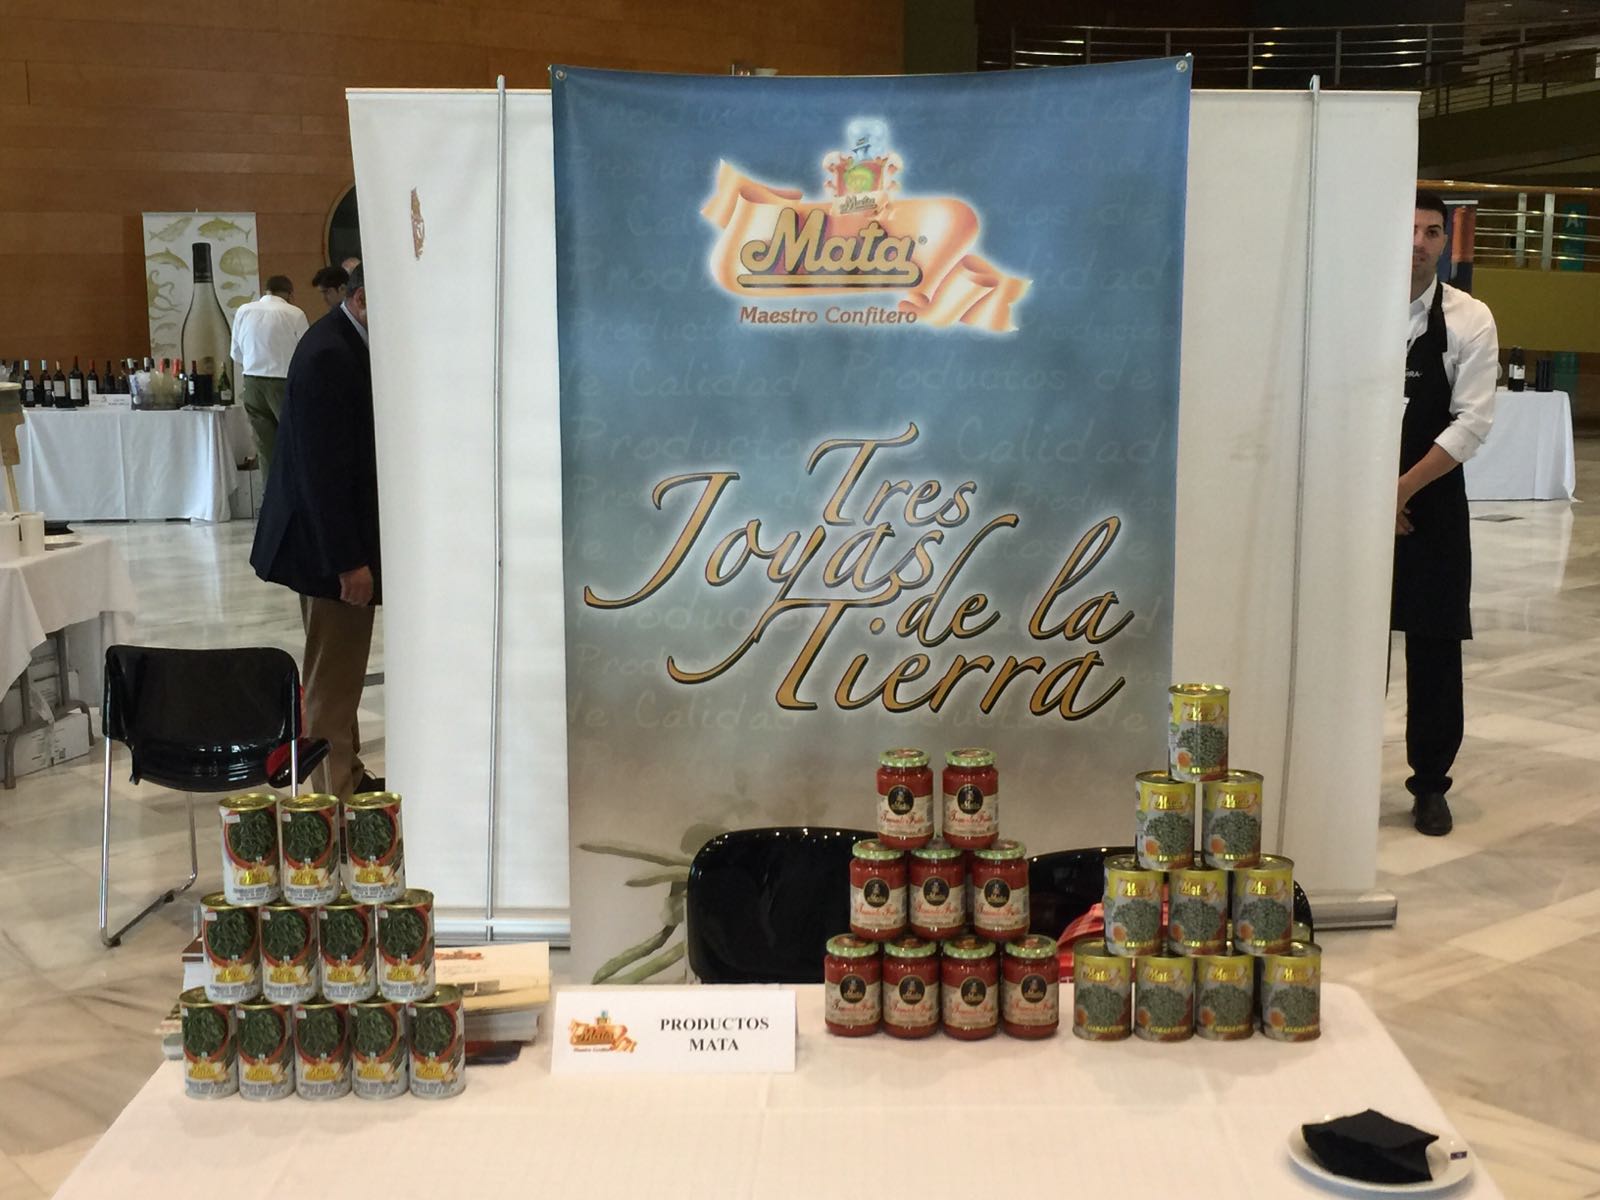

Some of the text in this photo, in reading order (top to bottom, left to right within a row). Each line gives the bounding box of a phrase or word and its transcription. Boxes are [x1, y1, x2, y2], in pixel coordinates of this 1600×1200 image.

[738, 207, 920, 282] Mata
[739, 305, 917, 327] Maestro Confitero
[570, 414, 802, 461] Producto
[806, 422, 977, 527] Tres
[584, 472, 945, 610] Joyas
[896, 513, 1135, 648] de la
[667, 588, 1127, 721] Tierra
[660, 1016, 770, 1032] PRODUCTOS
[689, 1037, 740, 1052] MATA
